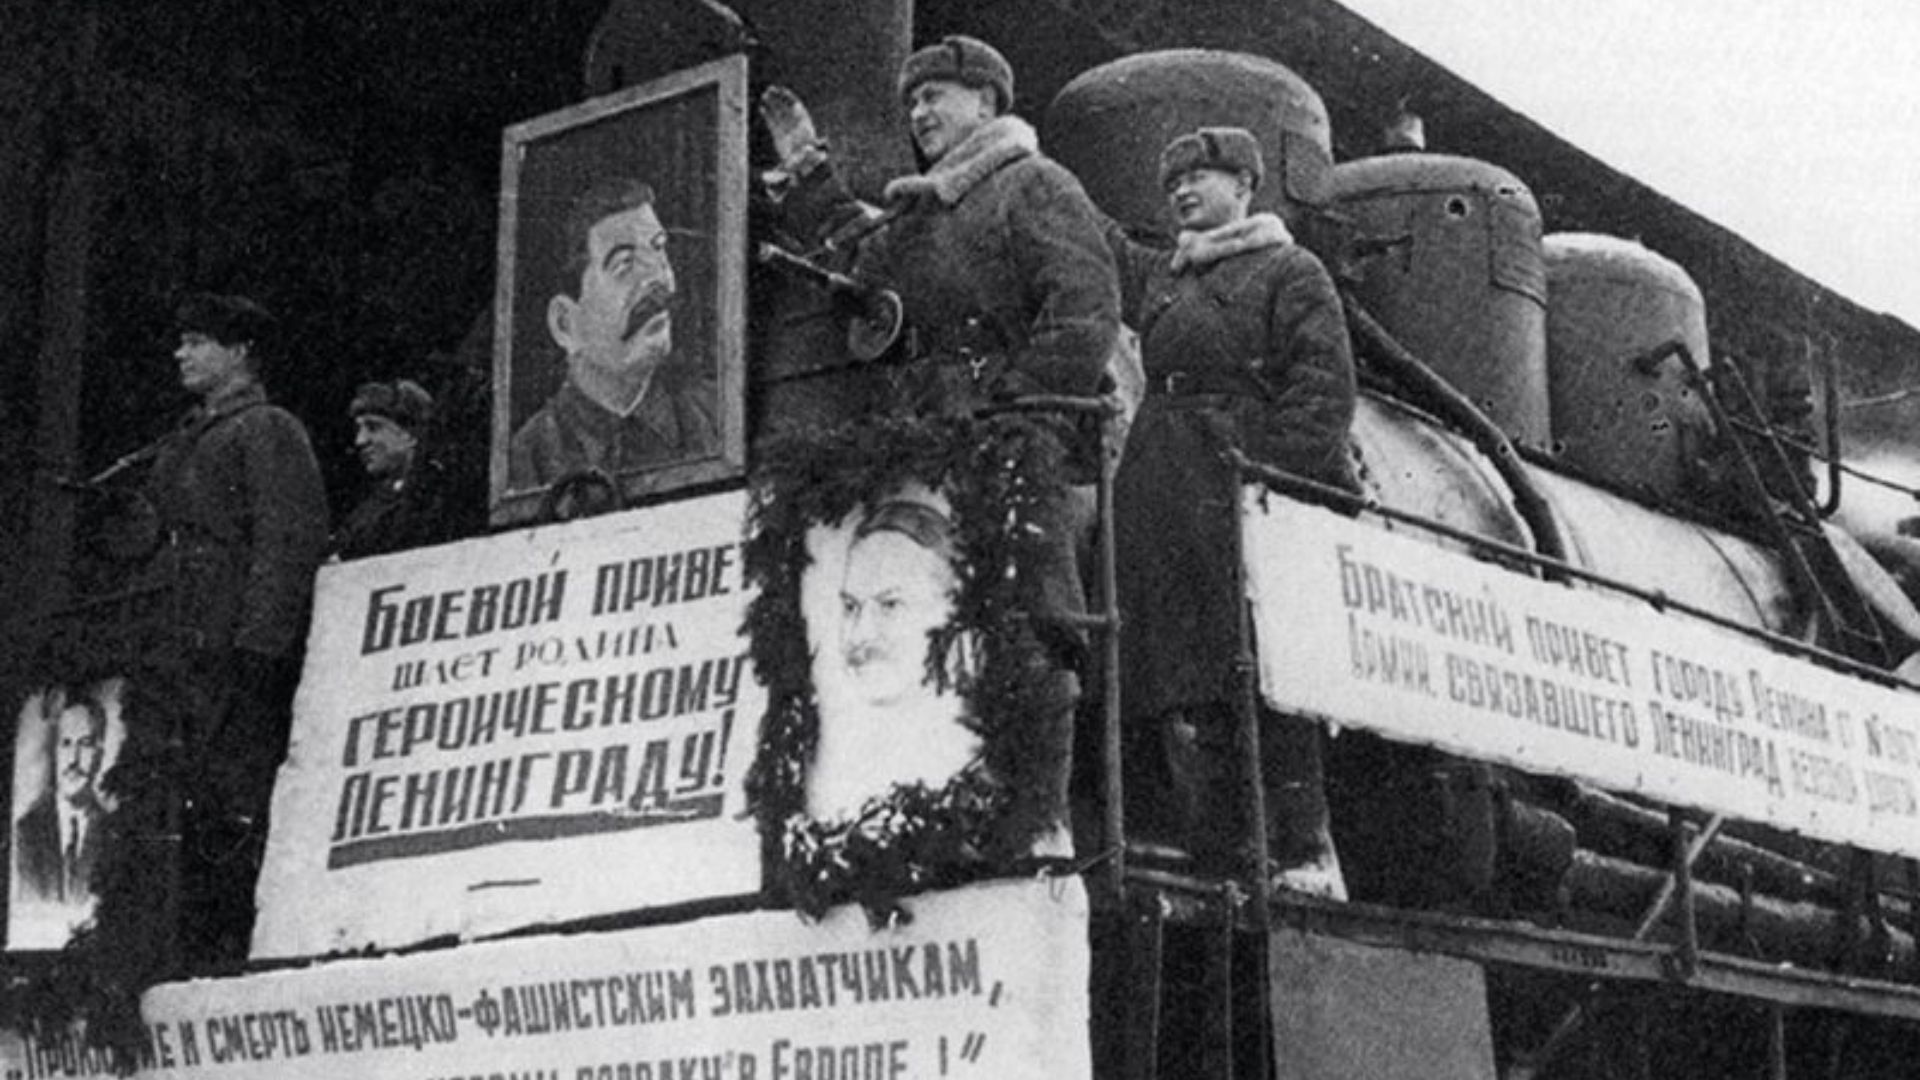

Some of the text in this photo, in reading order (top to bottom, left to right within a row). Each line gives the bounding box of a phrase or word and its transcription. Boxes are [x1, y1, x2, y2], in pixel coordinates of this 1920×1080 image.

[361, 550, 568, 657] БОЕВОЙ
[515, 622, 678, 671] РОДИНА
[342, 655, 747, 768] ГЕРОИЧЕСКОМУ
[1446, 652, 1639, 749] СВЯЗАВШЕГО
[331, 709, 735, 842] ЛЕНИНГРАДУ!
[178, 1019, 200, 1067] И
[205, 1010, 311, 1064] СМЕРТЬ
[316, 969, 695, 1053] НЕМЕЦКО-ФАШИСТСКИМ
[709, 938, 1002, 1017] ЗАХВАТЧИКАМ,
